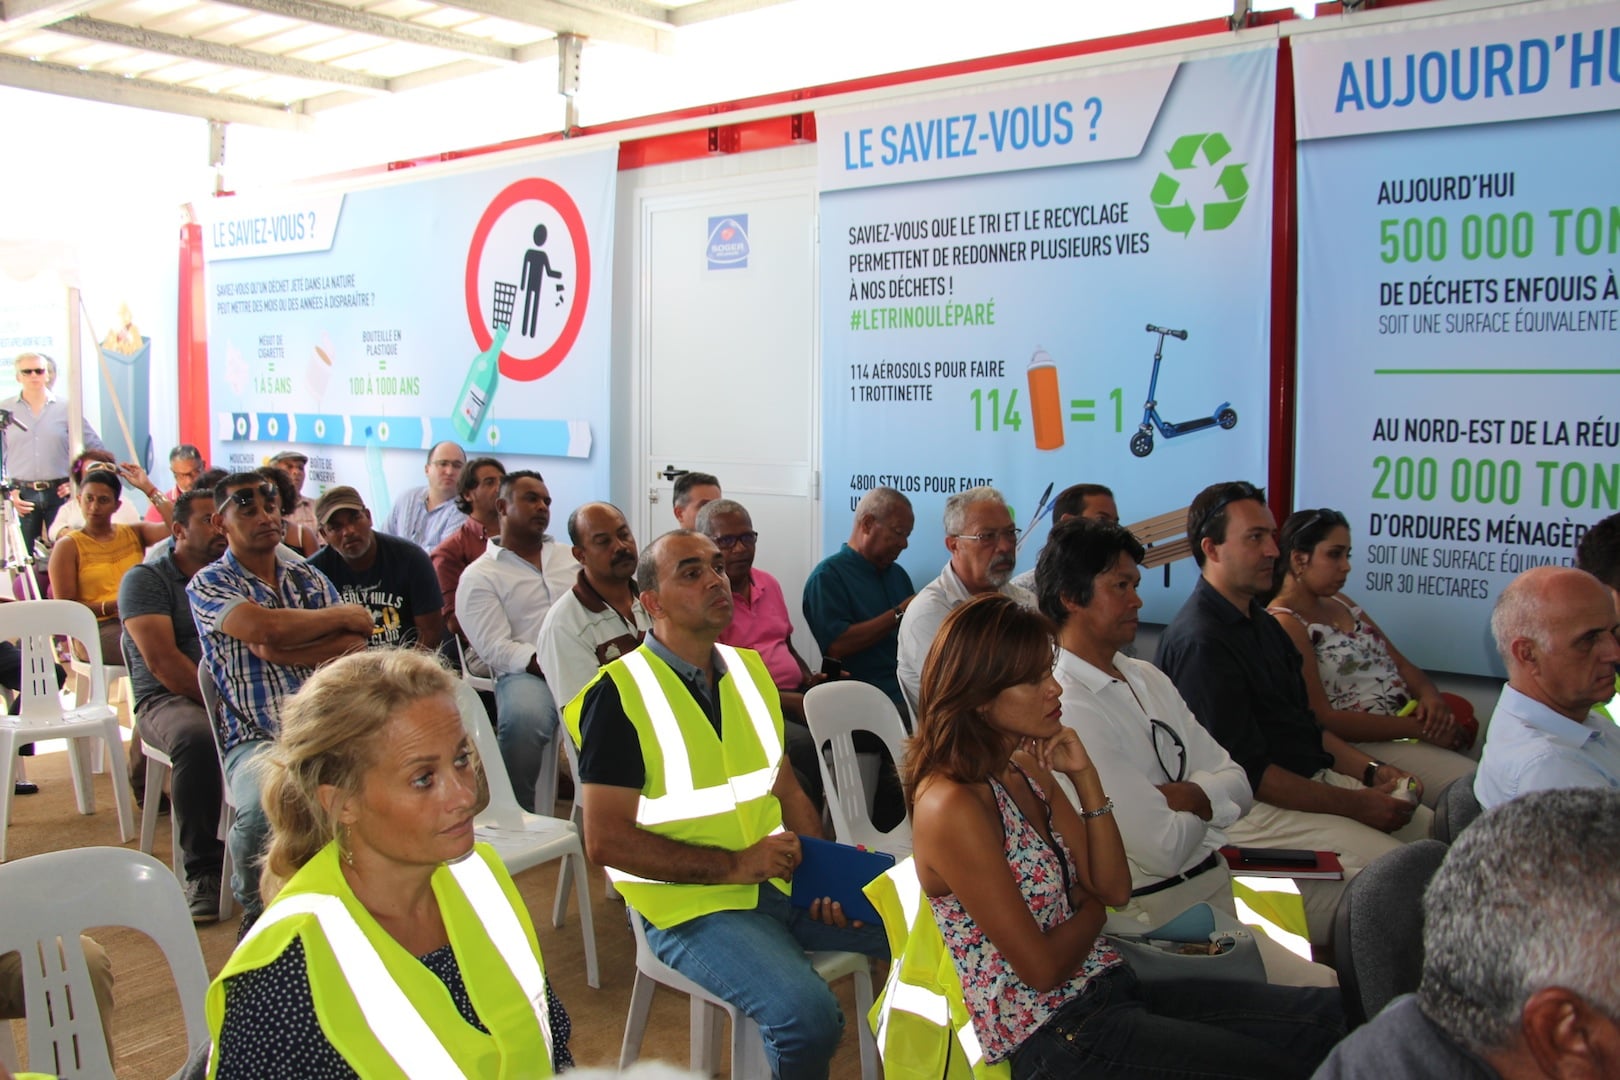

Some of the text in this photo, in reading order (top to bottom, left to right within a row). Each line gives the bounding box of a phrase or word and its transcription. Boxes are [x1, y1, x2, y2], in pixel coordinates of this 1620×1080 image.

[844, 97, 1102, 170] LE SAVIEZ-VOUS ?
[1377, 172, 1514, 205] AUJOURD'HUI
[213, 211, 316, 248] LE SAVIEZ-VOUS ?
[849, 202, 1129, 245] SAVIEZ-VOUS QUE LE TRI ET LE RECYCLAGE
[1380, 216, 1447, 264] 500
[1461, 212, 1534, 261] 000
[849, 232, 1149, 273] PERMETTENT DE REDONNER PLUSIEURS VIES
[331, 274, 355, 289] NATURE
[849, 275, 953, 301] À NOS DÉCHETS !
[1380, 268, 1620, 306] DE DÉCHETS ENFOUIS À
[288, 297, 299, 311] DES
[850, 297, 995, 330] #LETRINOULÉPARÉ
[1379, 307, 1618, 334] SOIT UNE SURFACE ÉQUIVALENTE
[363, 330, 402, 343] BOUTEILLE EN
[366, 344, 398, 356] PLASTIQUE
[850, 359, 1005, 380] 114 AÉROSOLS POUR FAIRE
[267, 377, 274, 393] 5
[274, 377, 292, 394] ANS
[349, 373, 420, 395] 100 À 1000 ANS
[859, 385, 933, 401] TROTTINETTE
[970, 389, 1022, 431] 114
[1110, 388, 1123, 432] 1
[1372, 415, 1619, 447] AU NORD-EST DE LA RÉU
[850, 474, 876, 490] 4800
[879, 475, 921, 492] STYLOS
[925, 476, 956, 493] POUR
[1371, 456, 1620, 510] 200 000 TON
[1370, 513, 1480, 542] D'ORDURES
[1368, 544, 1397, 565] SOIT
[1400, 546, 1428, 568] UNE
[1433, 548, 1496, 572] SURFACE
[1366, 572, 1489, 599] SUR 30 HECTARES
[371, 591, 404, 609] HILLS
